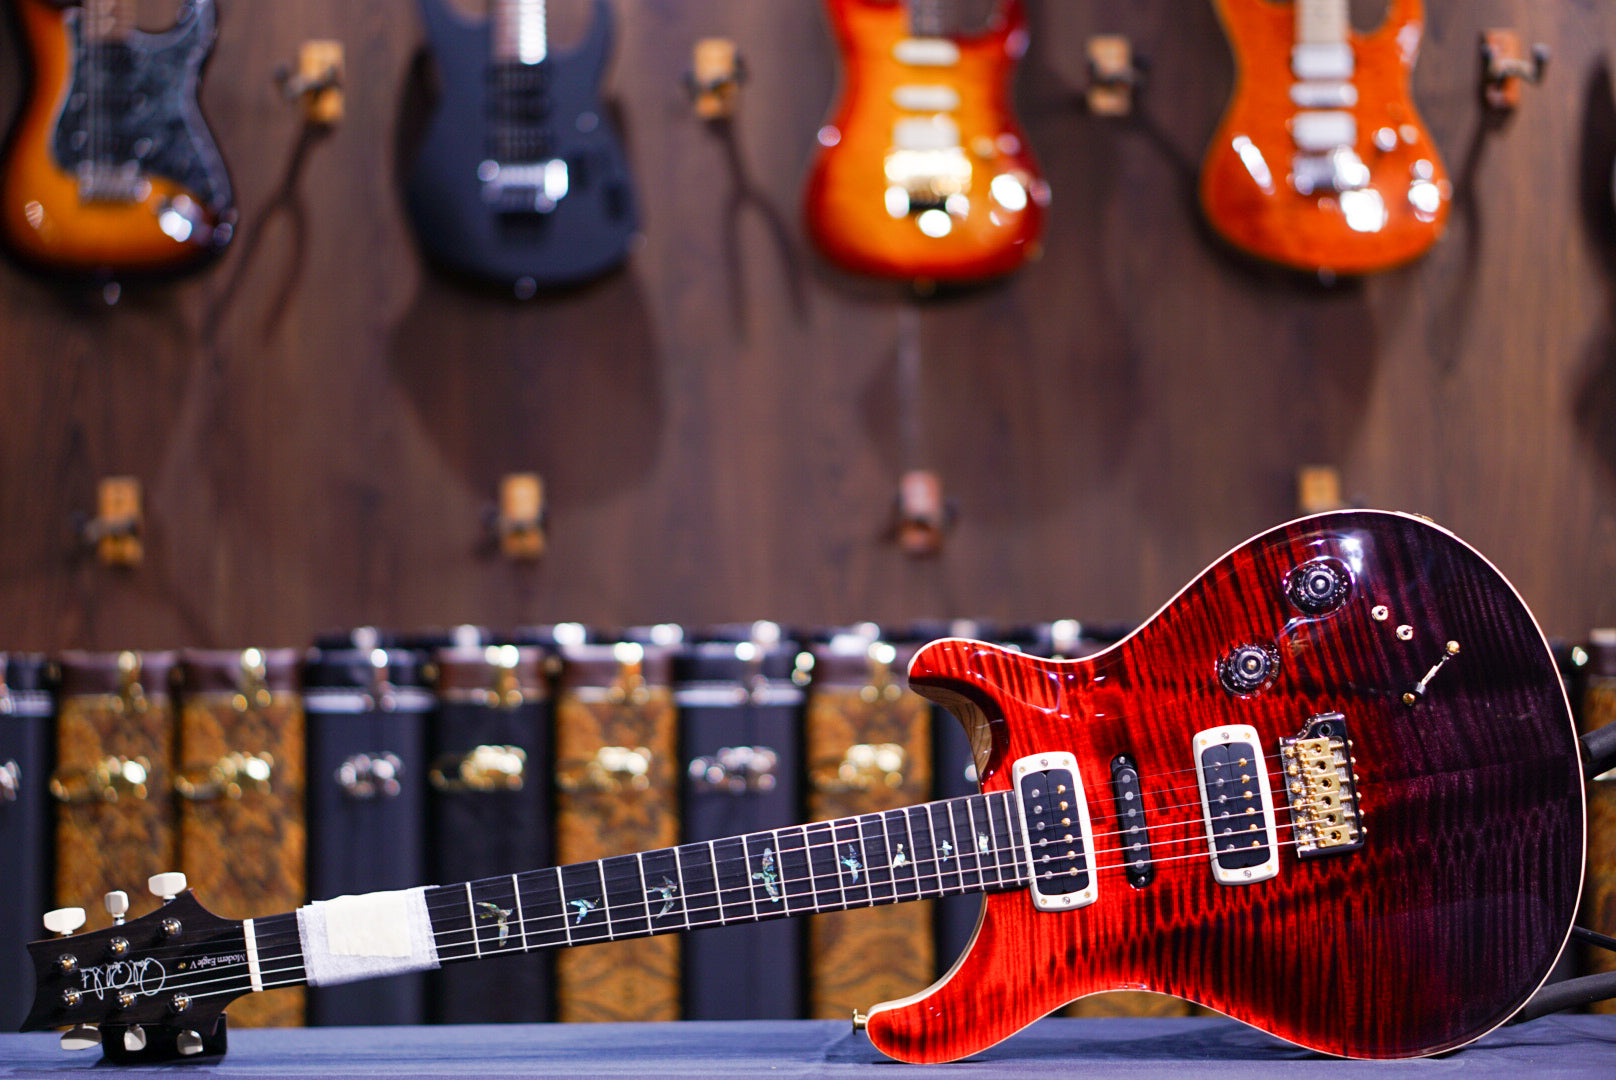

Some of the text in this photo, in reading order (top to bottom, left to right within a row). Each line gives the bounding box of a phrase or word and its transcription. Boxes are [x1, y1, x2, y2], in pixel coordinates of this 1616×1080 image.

[189, 953, 246, 969] Modern Eagle V
